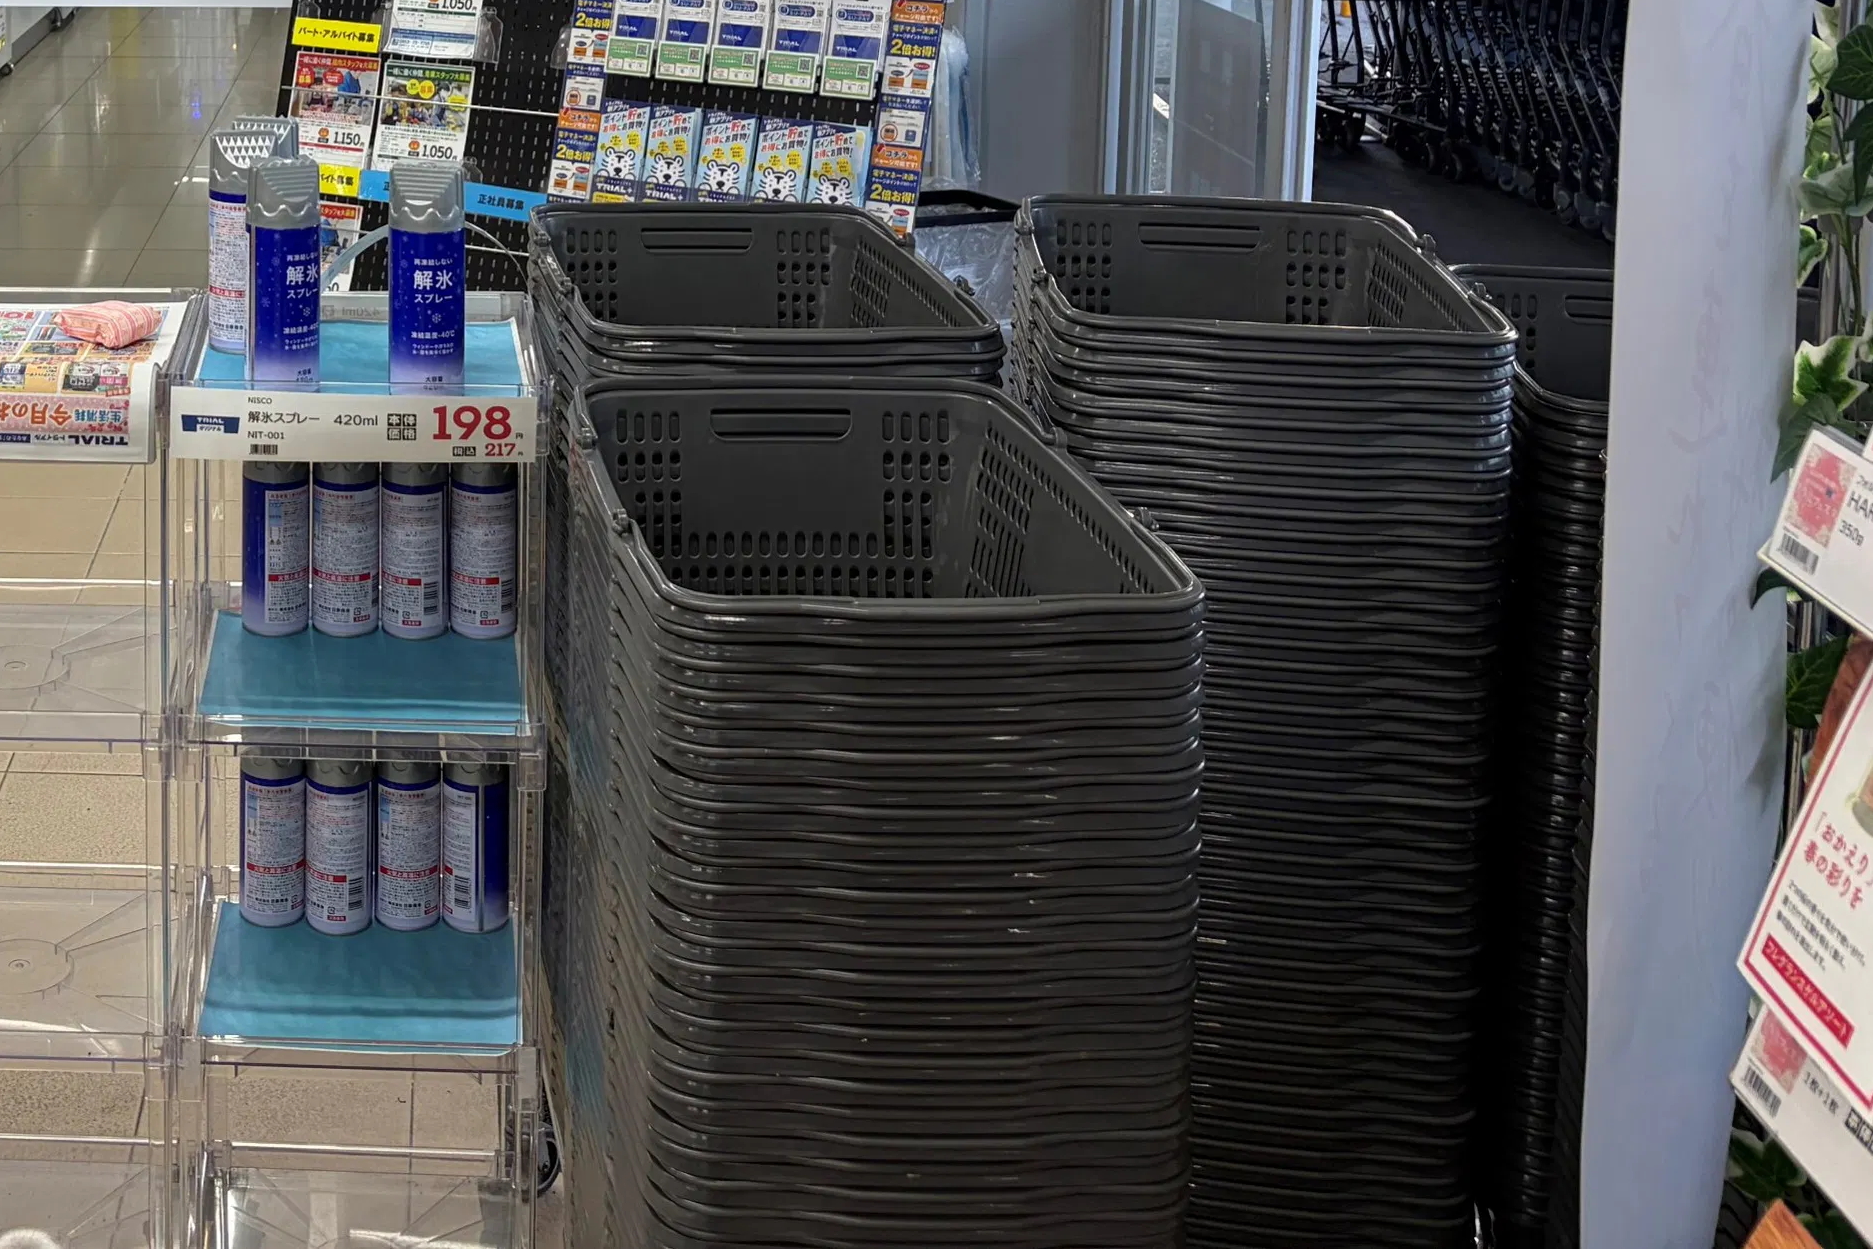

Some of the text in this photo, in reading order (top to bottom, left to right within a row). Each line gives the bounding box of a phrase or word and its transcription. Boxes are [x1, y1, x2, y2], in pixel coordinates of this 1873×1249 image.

[298, 26, 375, 43] パート・アルバイト募集
[890, 39, 936, 57] 2倍お得!
[603, 108, 647, 125] ポイント貯めて
[651, 113, 692, 130] ポイント貯めて
[705, 119, 751, 137] ポイント貯めて
[762, 126, 808, 142] ポイント貯めて
[814, 133, 854, 149] ポイント貯めて
[870, 183, 915, 204] 2倍お得!
[477, 193, 525, 211] 正社員募集
[413, 257, 453, 266] 再凍結しない
[286, 265, 319, 284] 解氷
[413, 269, 453, 290] 解氷
[286, 288, 318, 299] スプレー
[414, 294, 454, 304] スプレー
[247, 396, 273, 405] NISCO
[247, 411, 379, 426] 解氷スプレー 420ml
[387, 413, 417, 427] 本体
[199, 424, 222, 432] オリジナル
[247, 431, 285, 440] NIT-001
[387, 427, 417, 441] 価格
[34, 434, 129, 446] TRIAL トライアル
[452, 446, 477, 457] 税込
[1838, 519, 1865, 547] 350g
[1803, 839, 1864, 911] 春の彩りを
